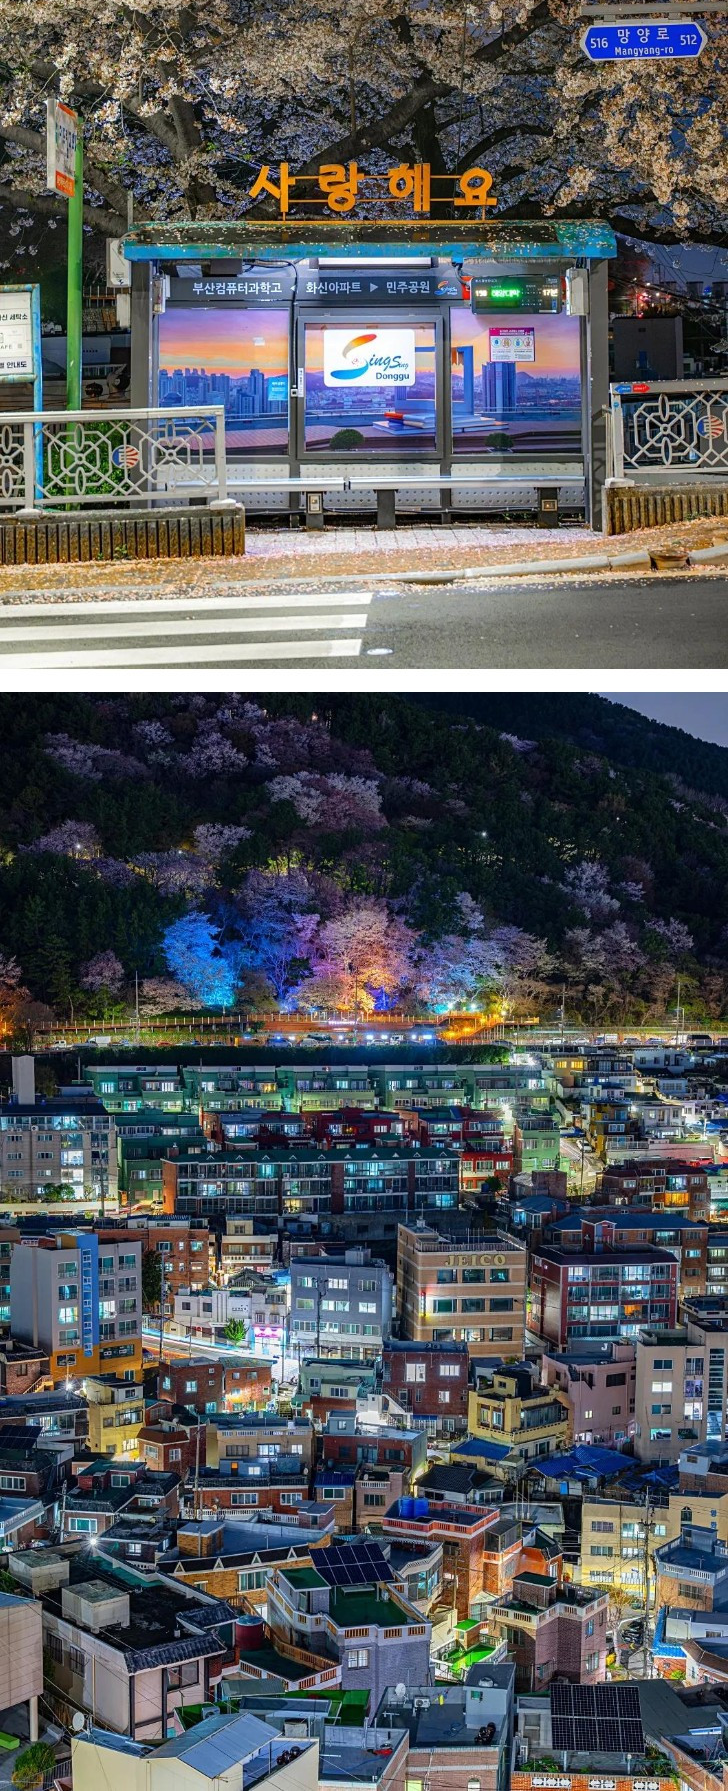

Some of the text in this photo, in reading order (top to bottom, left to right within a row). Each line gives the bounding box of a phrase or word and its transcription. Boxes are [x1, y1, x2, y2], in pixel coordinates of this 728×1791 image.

[590, 27, 698, 49] 516 망양로 512
[614, 45, 674, 57] Mangyang-ro
[249, 162, 498, 212] 사랑해요
[192, 282, 283, 296] 부산컴퓨터과학고
[305, 281, 363, 294] 화신아파트
[386, 280, 431, 294] 민주공원
[6, 360, 28, 369] 안내도
[375, 371, 410, 382] Donggu
[444, 1254, 506, 1266] JEICO
